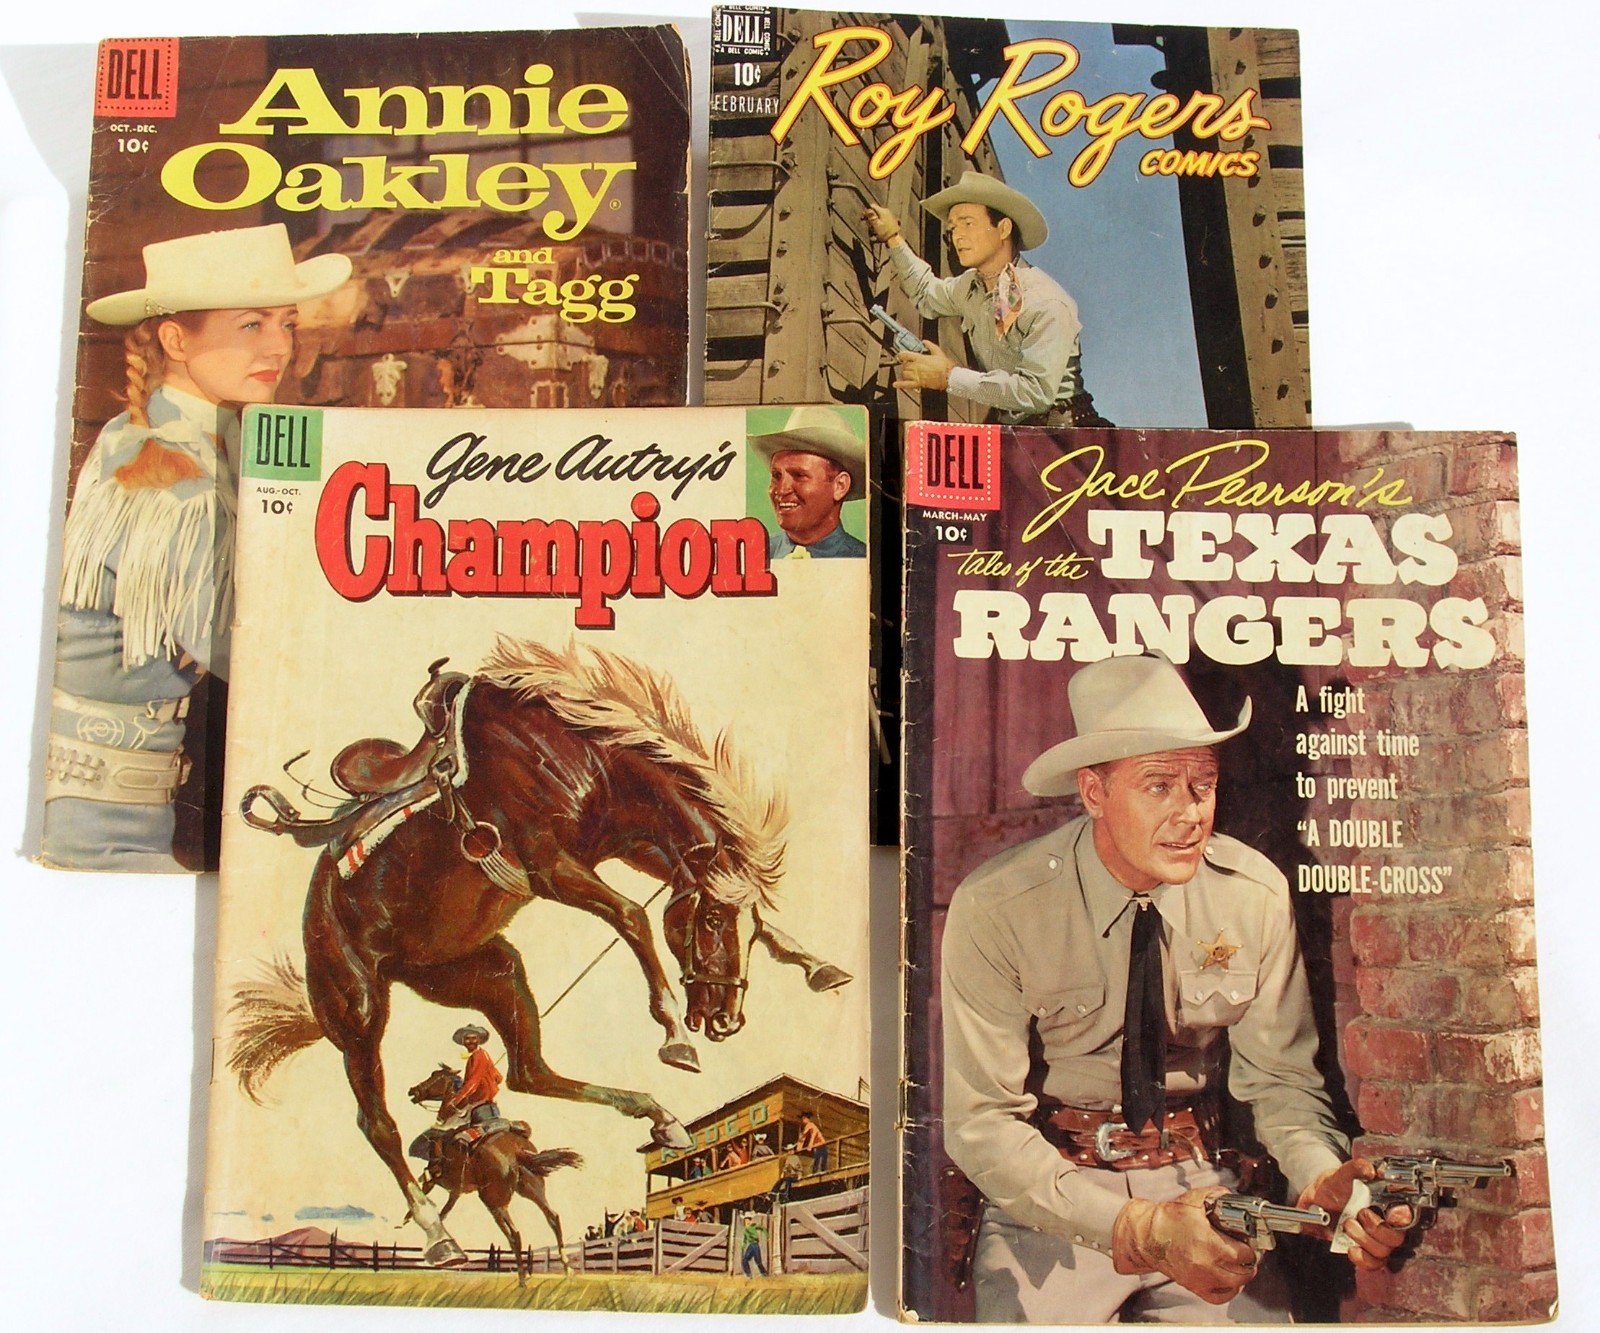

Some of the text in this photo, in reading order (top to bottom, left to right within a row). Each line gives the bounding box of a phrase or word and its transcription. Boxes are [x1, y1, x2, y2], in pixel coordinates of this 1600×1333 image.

[722, 14, 763, 44] DELL
[744, 48, 764, 56] COMIC
[106, 48, 163, 100] DELL
[734, 62, 761, 87] 10¢
[218, 64, 630, 137] Annie
[714, 95, 779, 114] FEBRUARY
[770, 24, 1271, 188] Roy Rogers
[110, 123, 158, 134] OCT.-DEC.
[117, 138, 150, 154] 10¢
[1139, 149, 1263, 178] COMICS
[160, 141, 637, 241] Oakley
[493, 247, 555, 264] and
[471, 267, 640, 324] Tagg
[255, 412, 311, 468] DELL
[424, 431, 737, 508] Gene Autry's
[926, 432, 984, 490] DELL
[256, 486, 302, 496] AUG.-OCT.
[261, 499, 294, 515] 10¢
[1022, 439, 1413, 543] Jace Pearson's
[922, 510, 988, 522] MARCH-MAY
[314, 460, 779, 630] Champion
[935, 525, 968, 542] 10¢
[1087, 509, 1459, 586] TEXAS
[947, 548, 1094, 588] Tales of the
[953, 589, 1496, 669] RANGERS
[1295, 684, 1366, 719] A fight
[1295, 728, 1421, 760] against time
[1295, 771, 1399, 805] to prevent
[1328, 818, 1404, 848] DOUBLE
